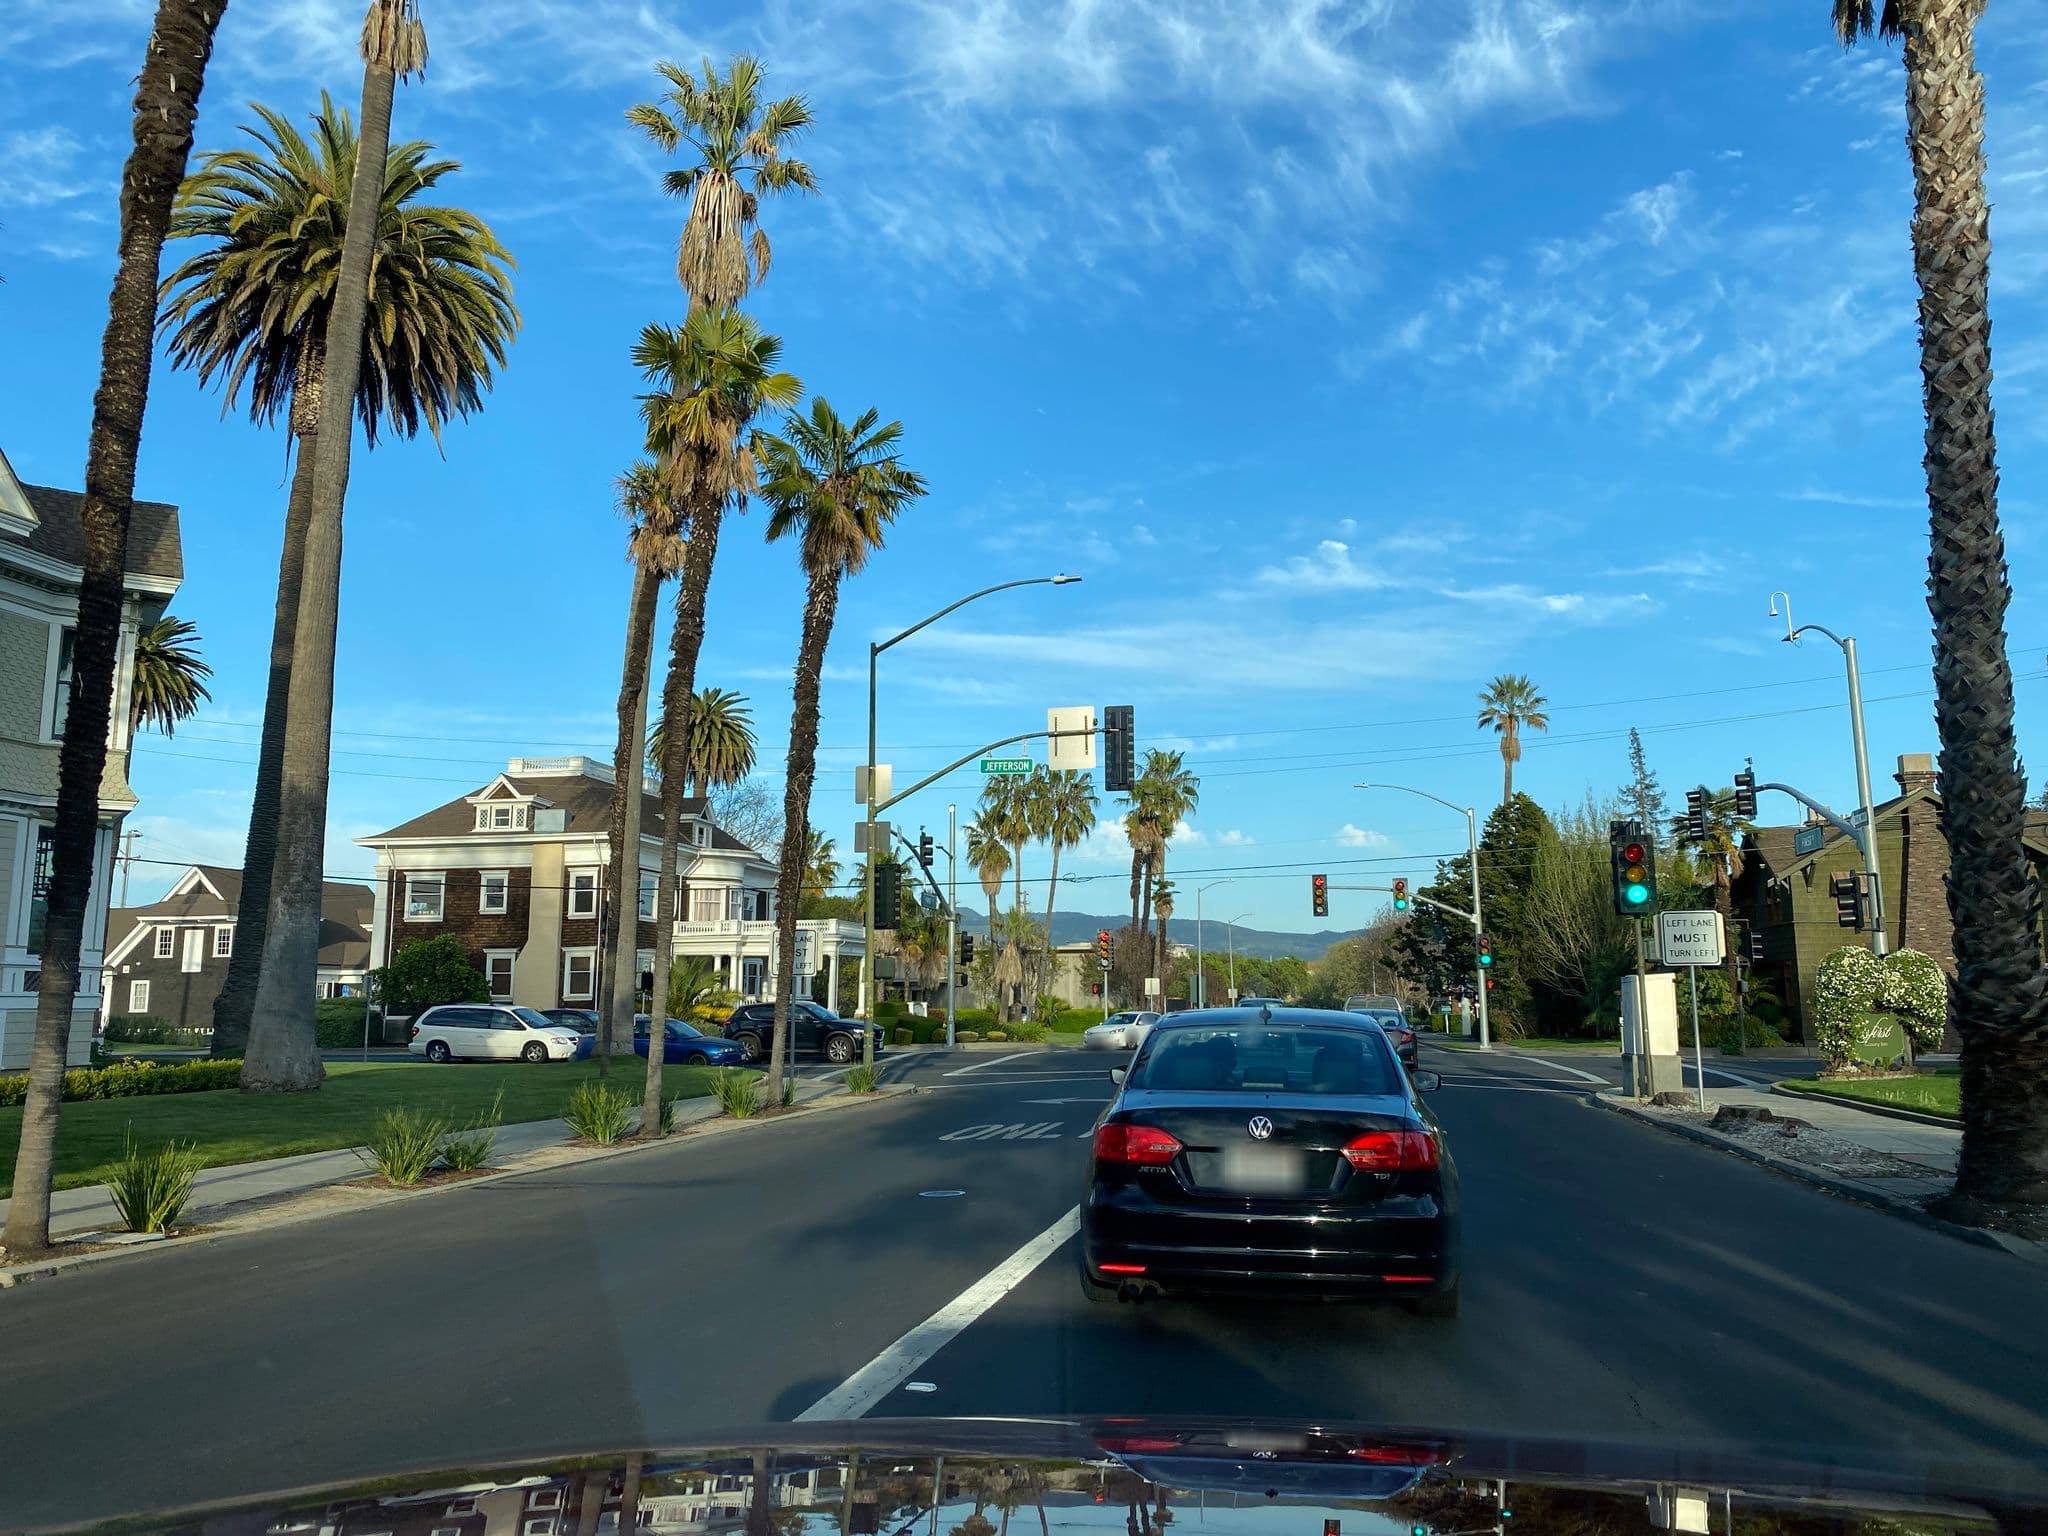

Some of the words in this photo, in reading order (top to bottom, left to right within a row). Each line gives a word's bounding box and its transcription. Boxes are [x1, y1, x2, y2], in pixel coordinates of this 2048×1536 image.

[984, 761, 1030, 771] JEFFERSON
[1666, 919, 1687, 928] LEFT
[1691, 919, 1714, 927] LANE
[1673, 933, 1709, 943] MUST
[795, 948, 808, 957] ST
[1669, 949, 1691, 957] TURN
[1694, 949, 1715, 957] LEFT
[795, 962, 812, 970] LEFT
